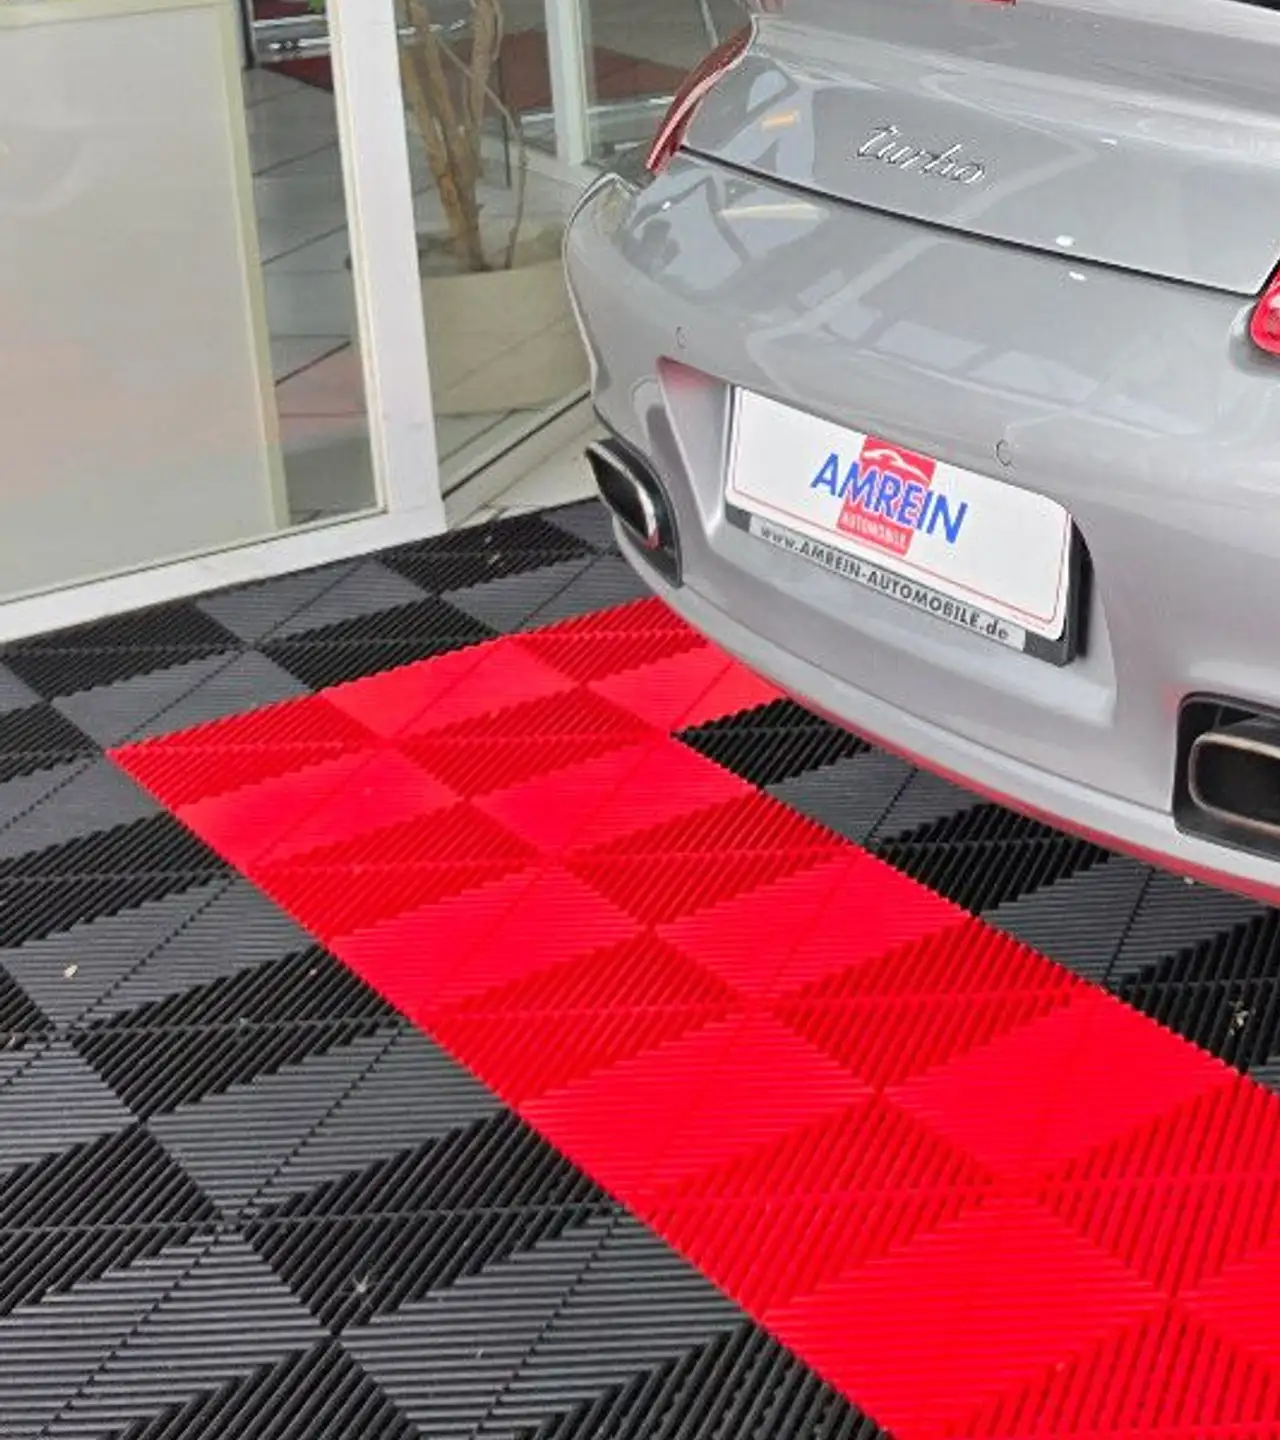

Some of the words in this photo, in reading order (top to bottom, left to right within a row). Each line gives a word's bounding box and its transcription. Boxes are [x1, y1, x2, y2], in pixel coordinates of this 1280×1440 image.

[857, 125, 985, 185] turbo
[810, 452, 969, 545] AMREIN
[761, 525, 1010, 641] www.AMREIN-AUTOMOBILE.de
